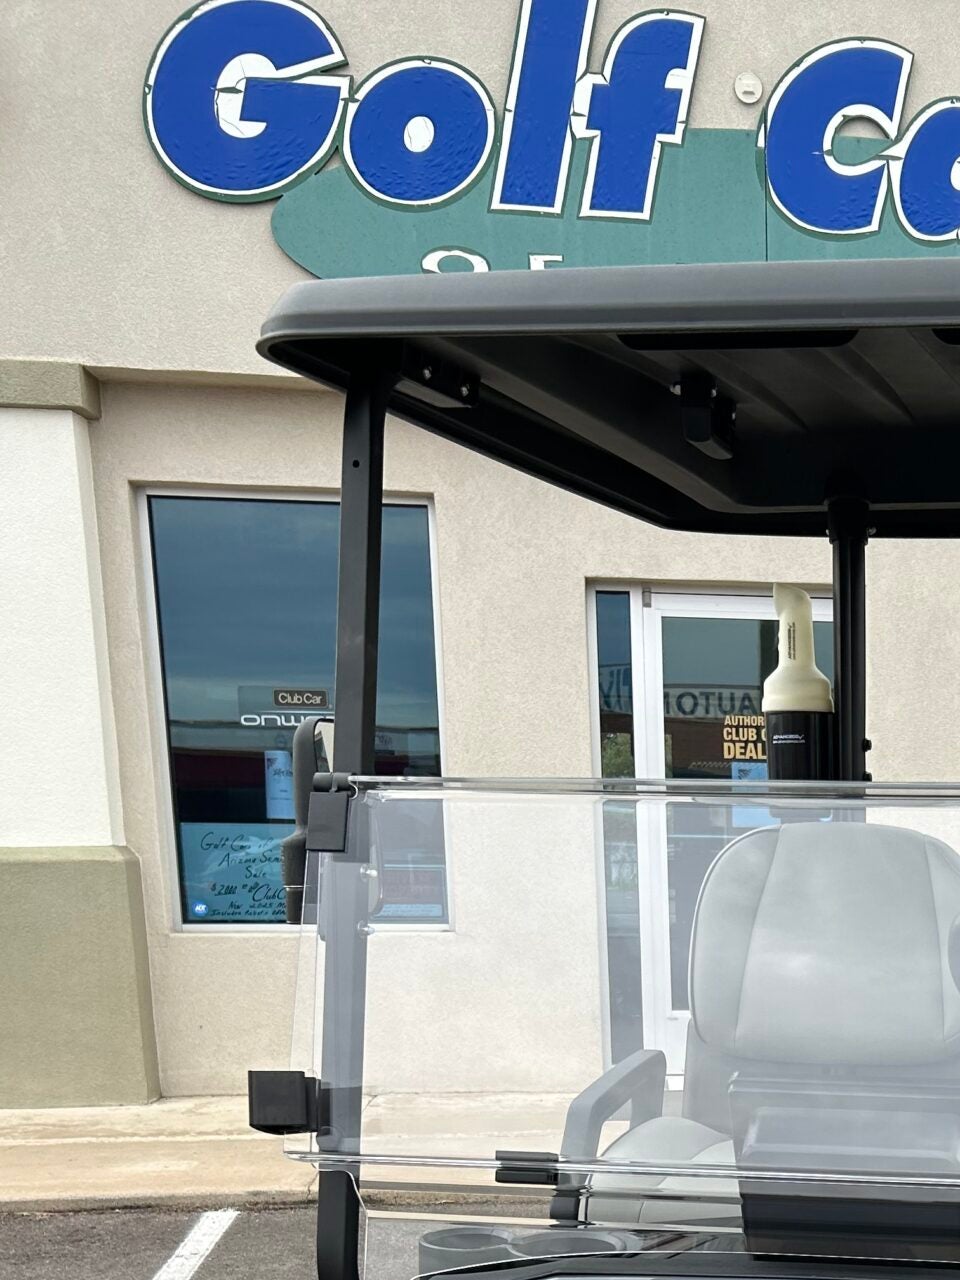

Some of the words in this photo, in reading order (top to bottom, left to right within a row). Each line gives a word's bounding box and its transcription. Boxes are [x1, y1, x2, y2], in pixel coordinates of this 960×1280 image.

[146, 0, 704, 220] Golf
[278, 692, 303, 704] Club
[303, 692, 322, 704] Car
[723, 727, 758, 742] CLUB
[723, 742, 767, 760] DEAL
